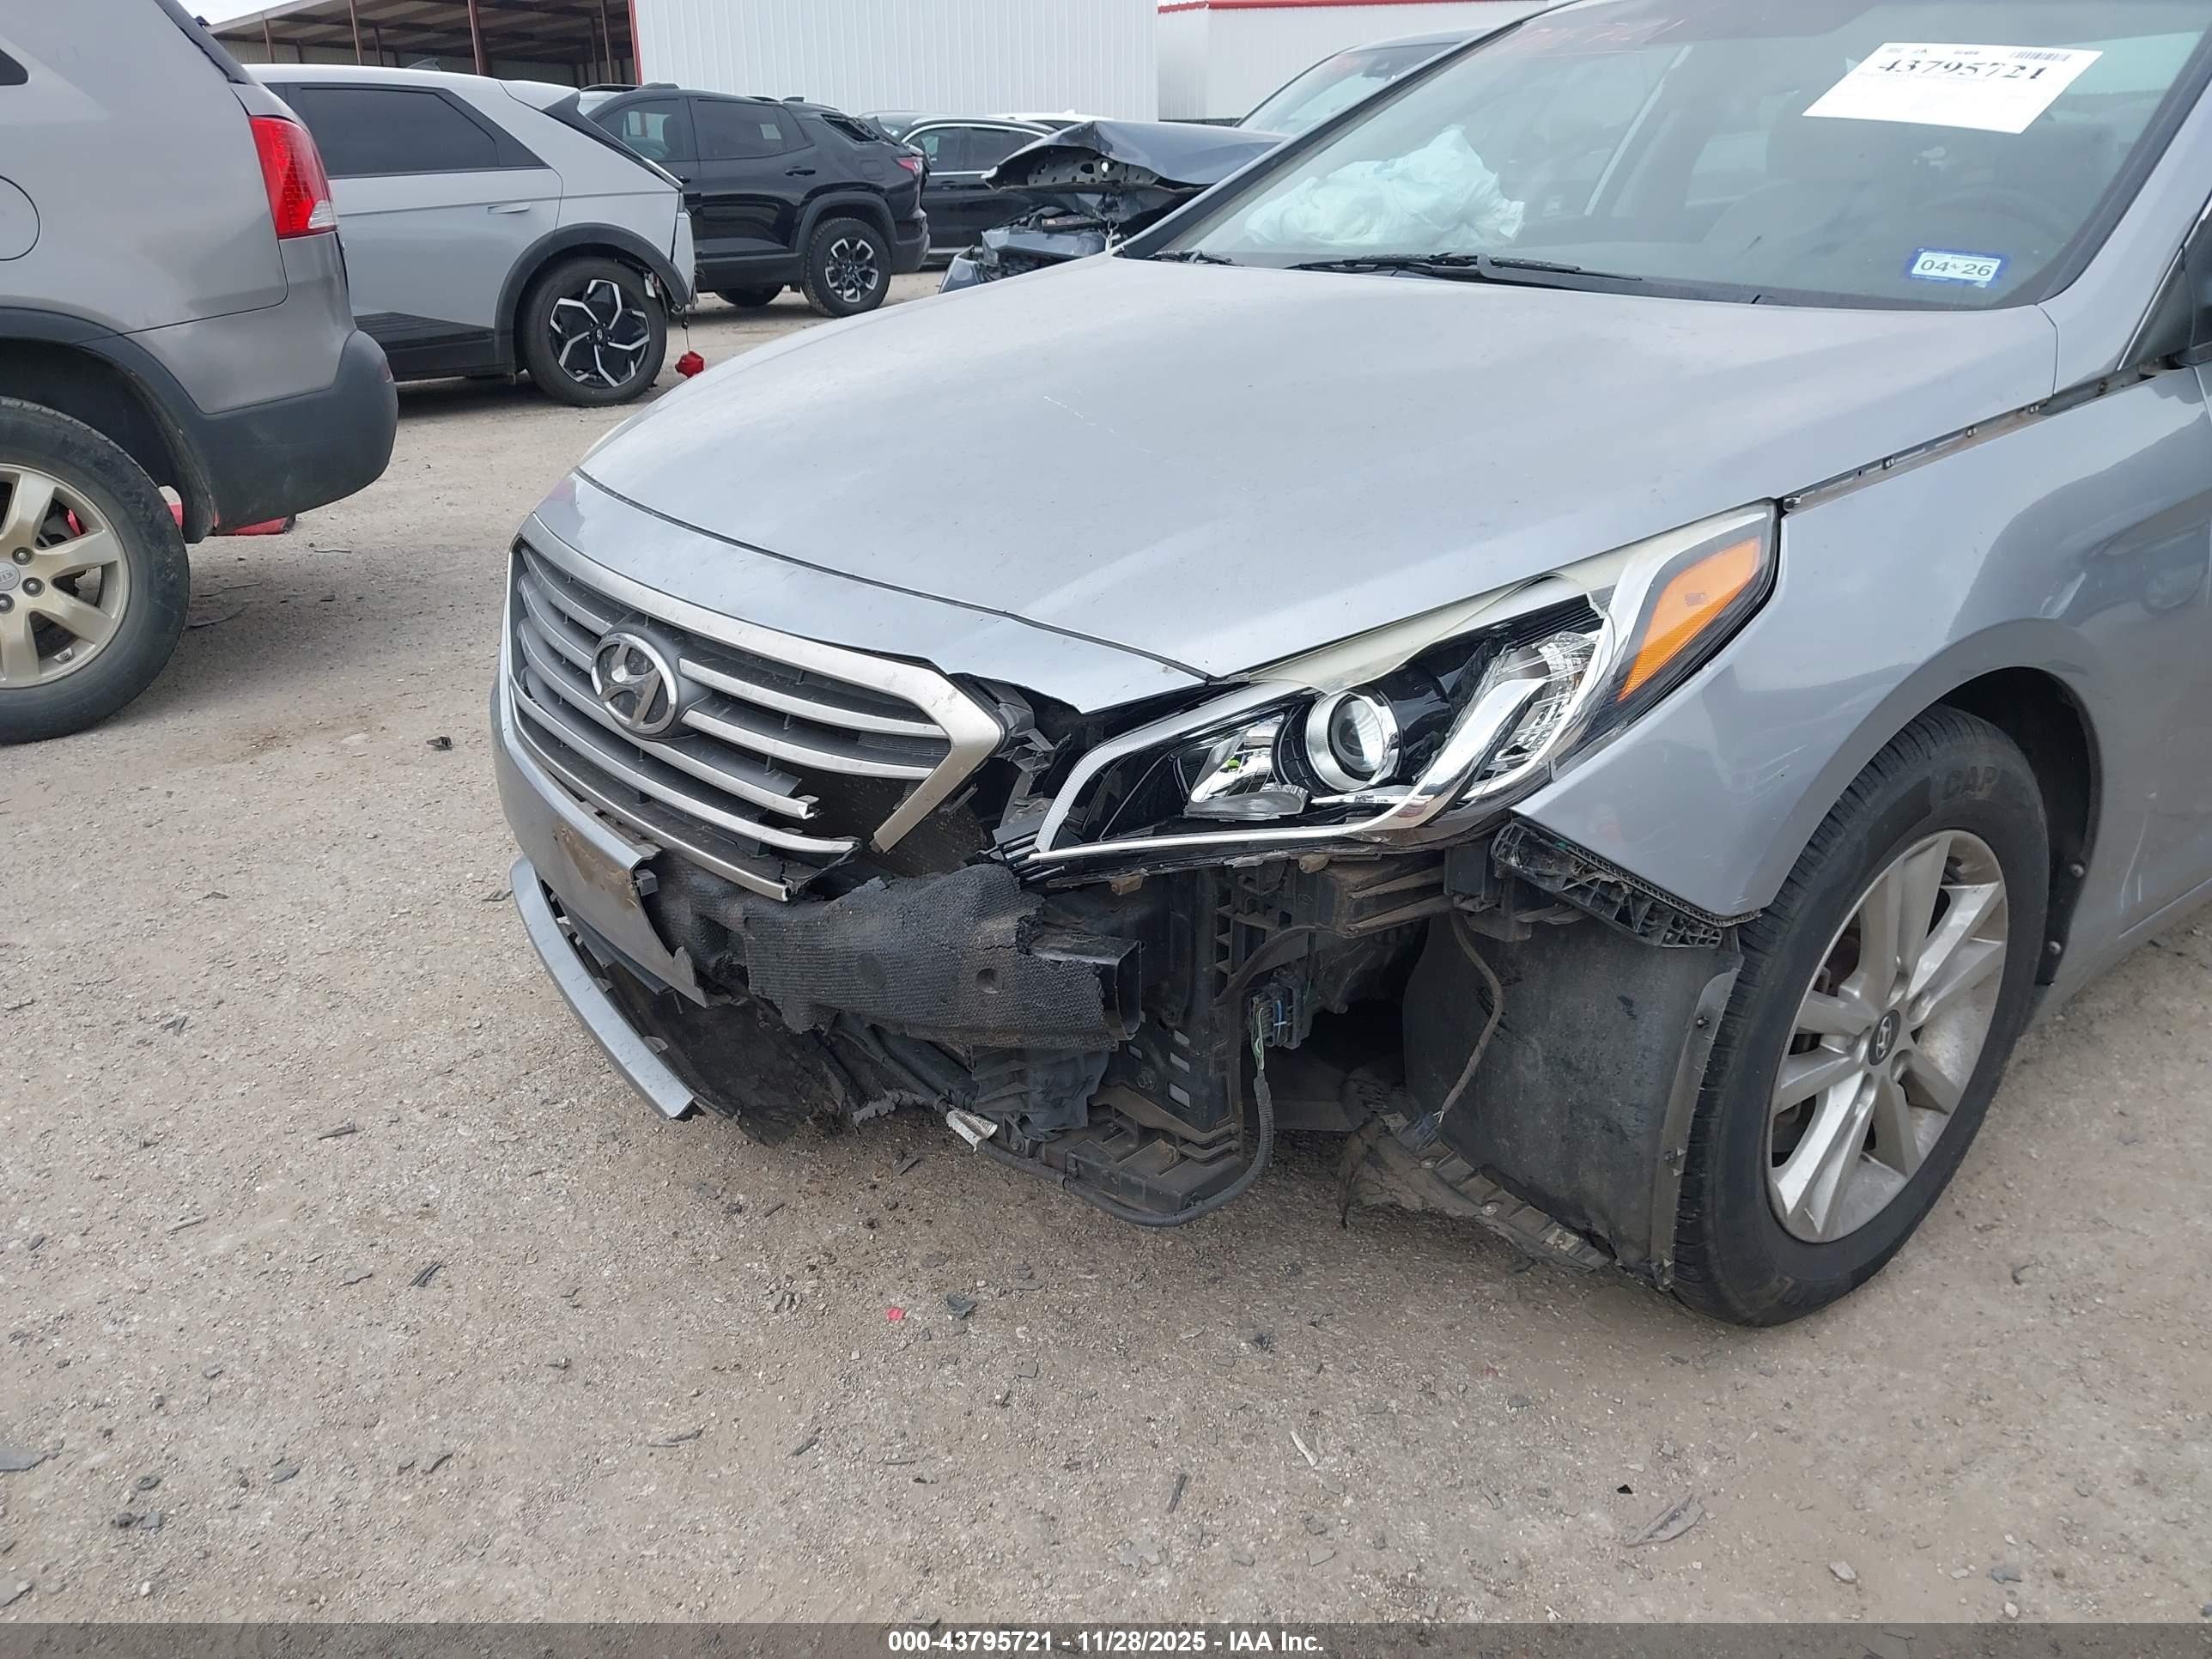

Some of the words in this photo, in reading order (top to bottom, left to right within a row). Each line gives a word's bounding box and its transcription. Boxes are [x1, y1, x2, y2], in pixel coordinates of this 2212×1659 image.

[1878, 59, 2047, 80] 43795721
[1920, 259, 1950, 272] 04
[1961, 263, 1993, 276] 26
